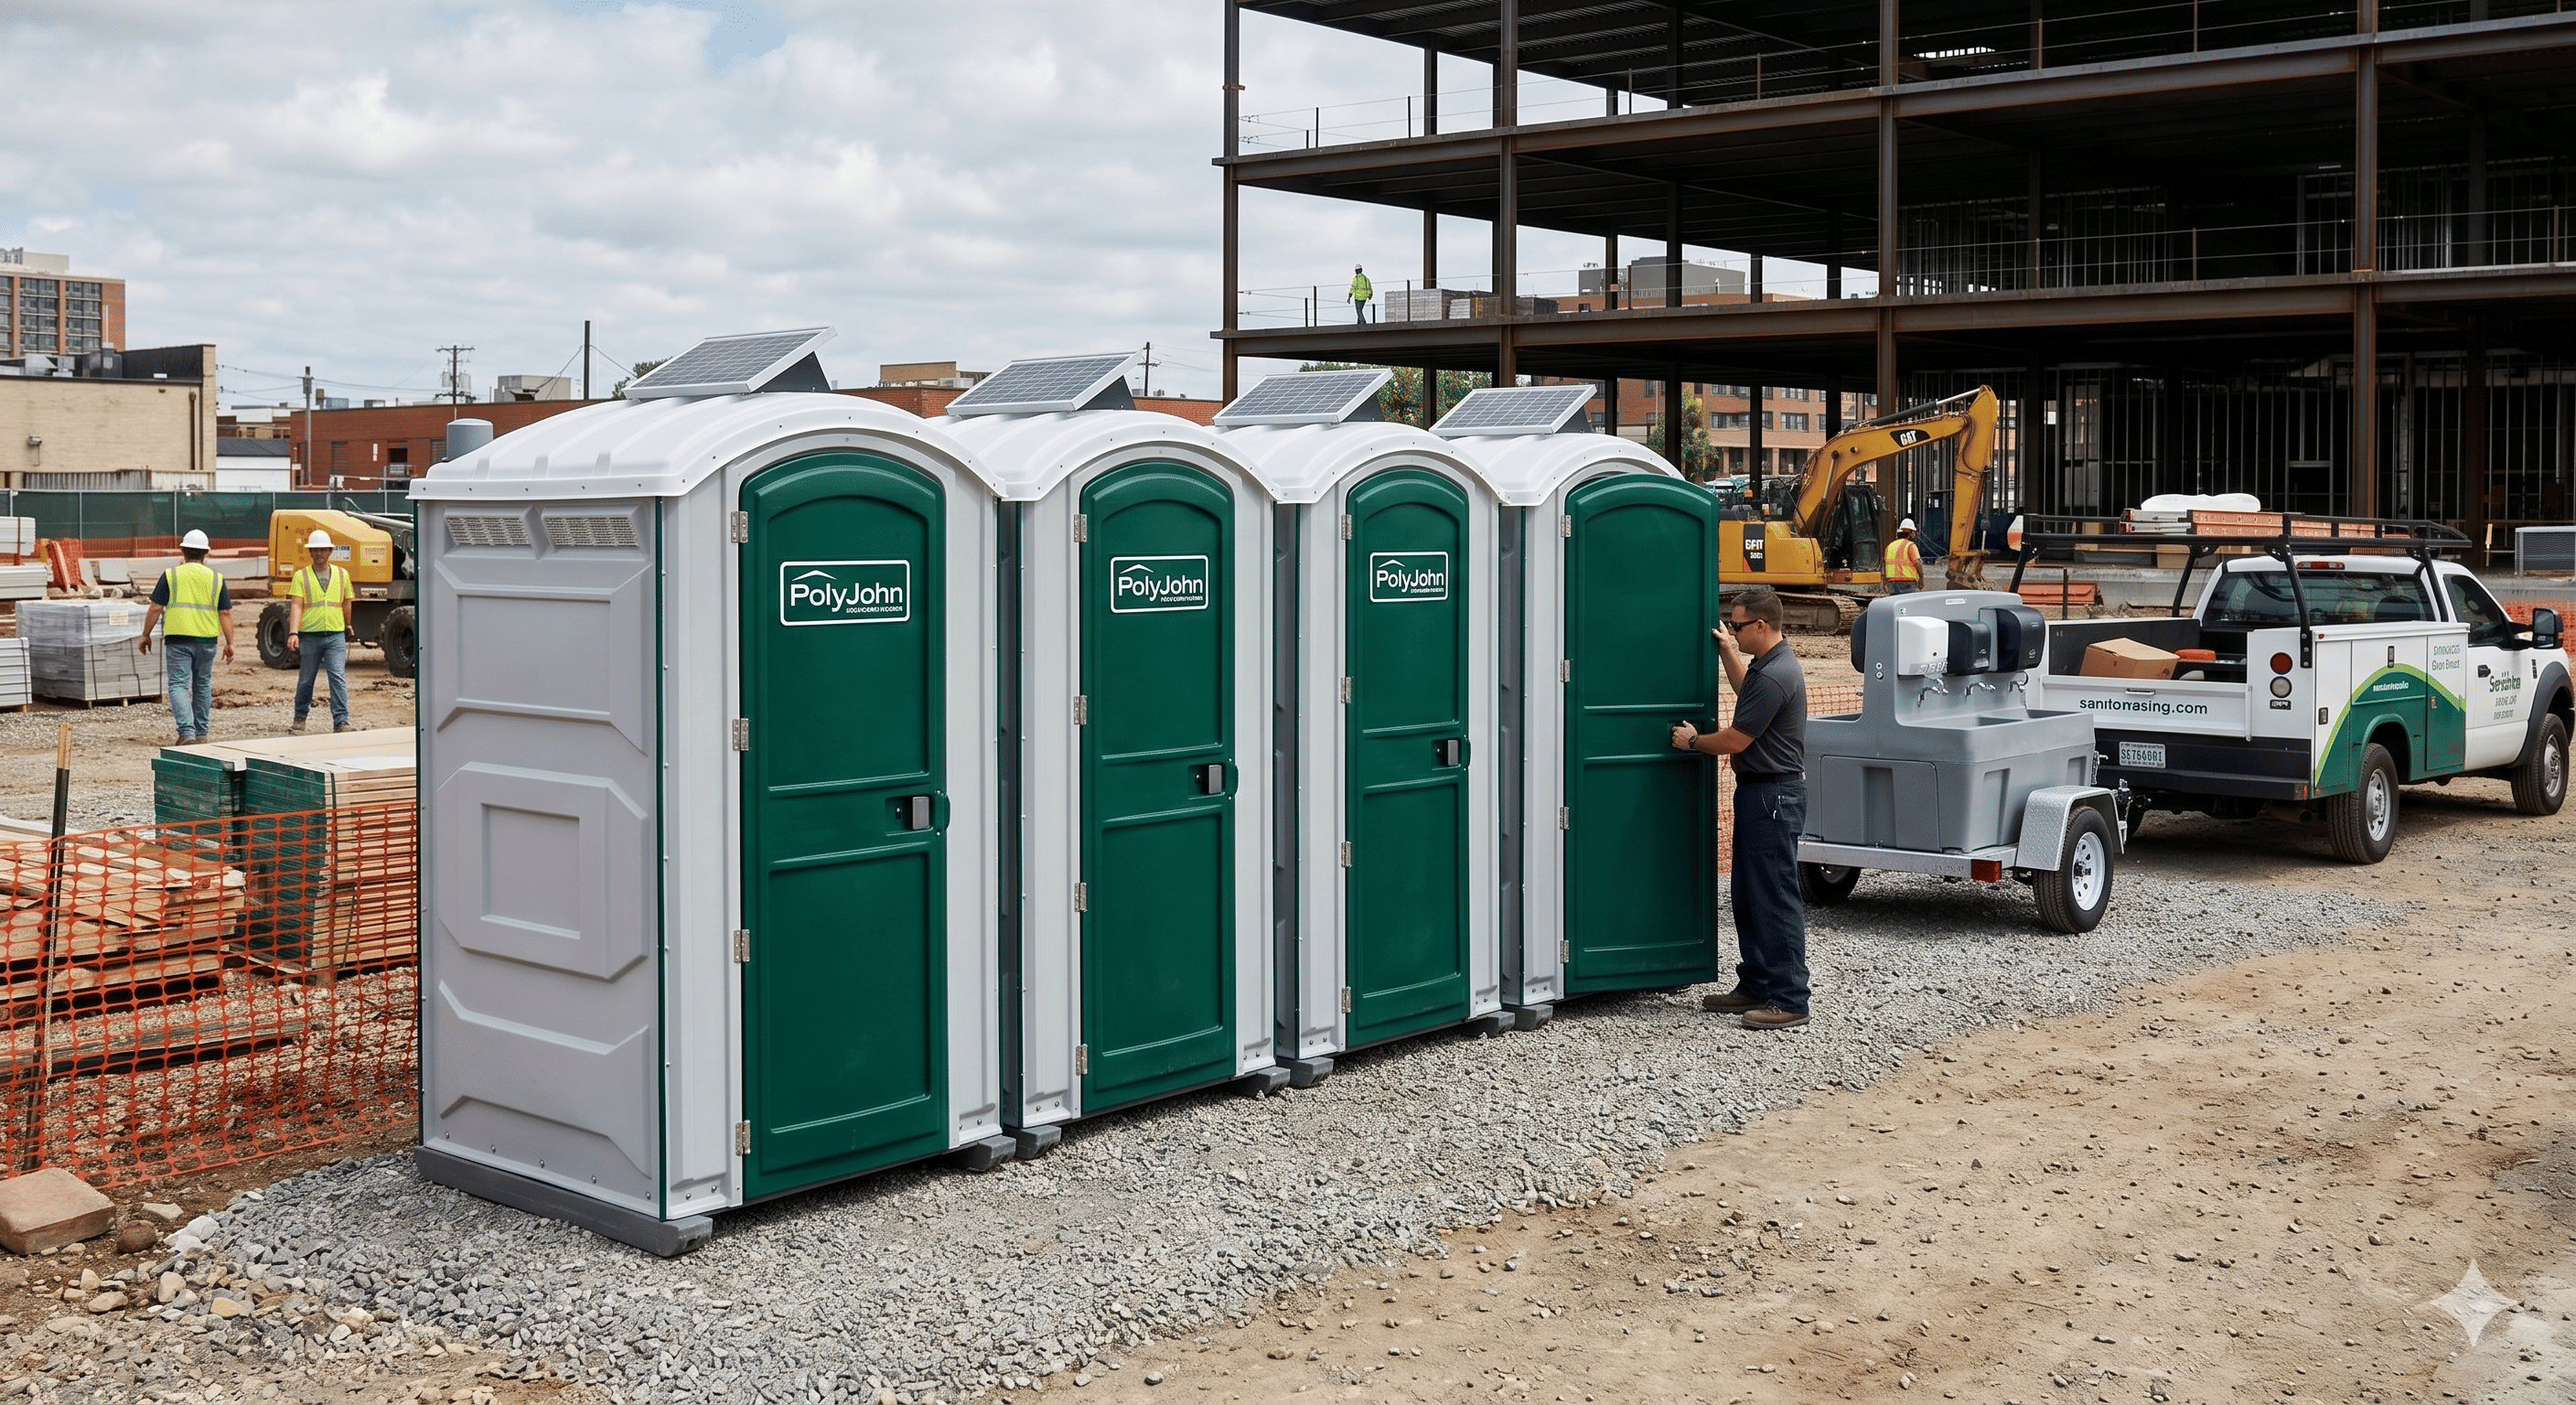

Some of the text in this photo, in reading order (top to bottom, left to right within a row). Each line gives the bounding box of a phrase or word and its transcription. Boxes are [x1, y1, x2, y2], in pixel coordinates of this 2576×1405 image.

[1118, 574, 1203, 602] PolyJohn
[1376, 568, 1444, 593] PolyJohn
[790, 582, 903, 613] PolyJohn
